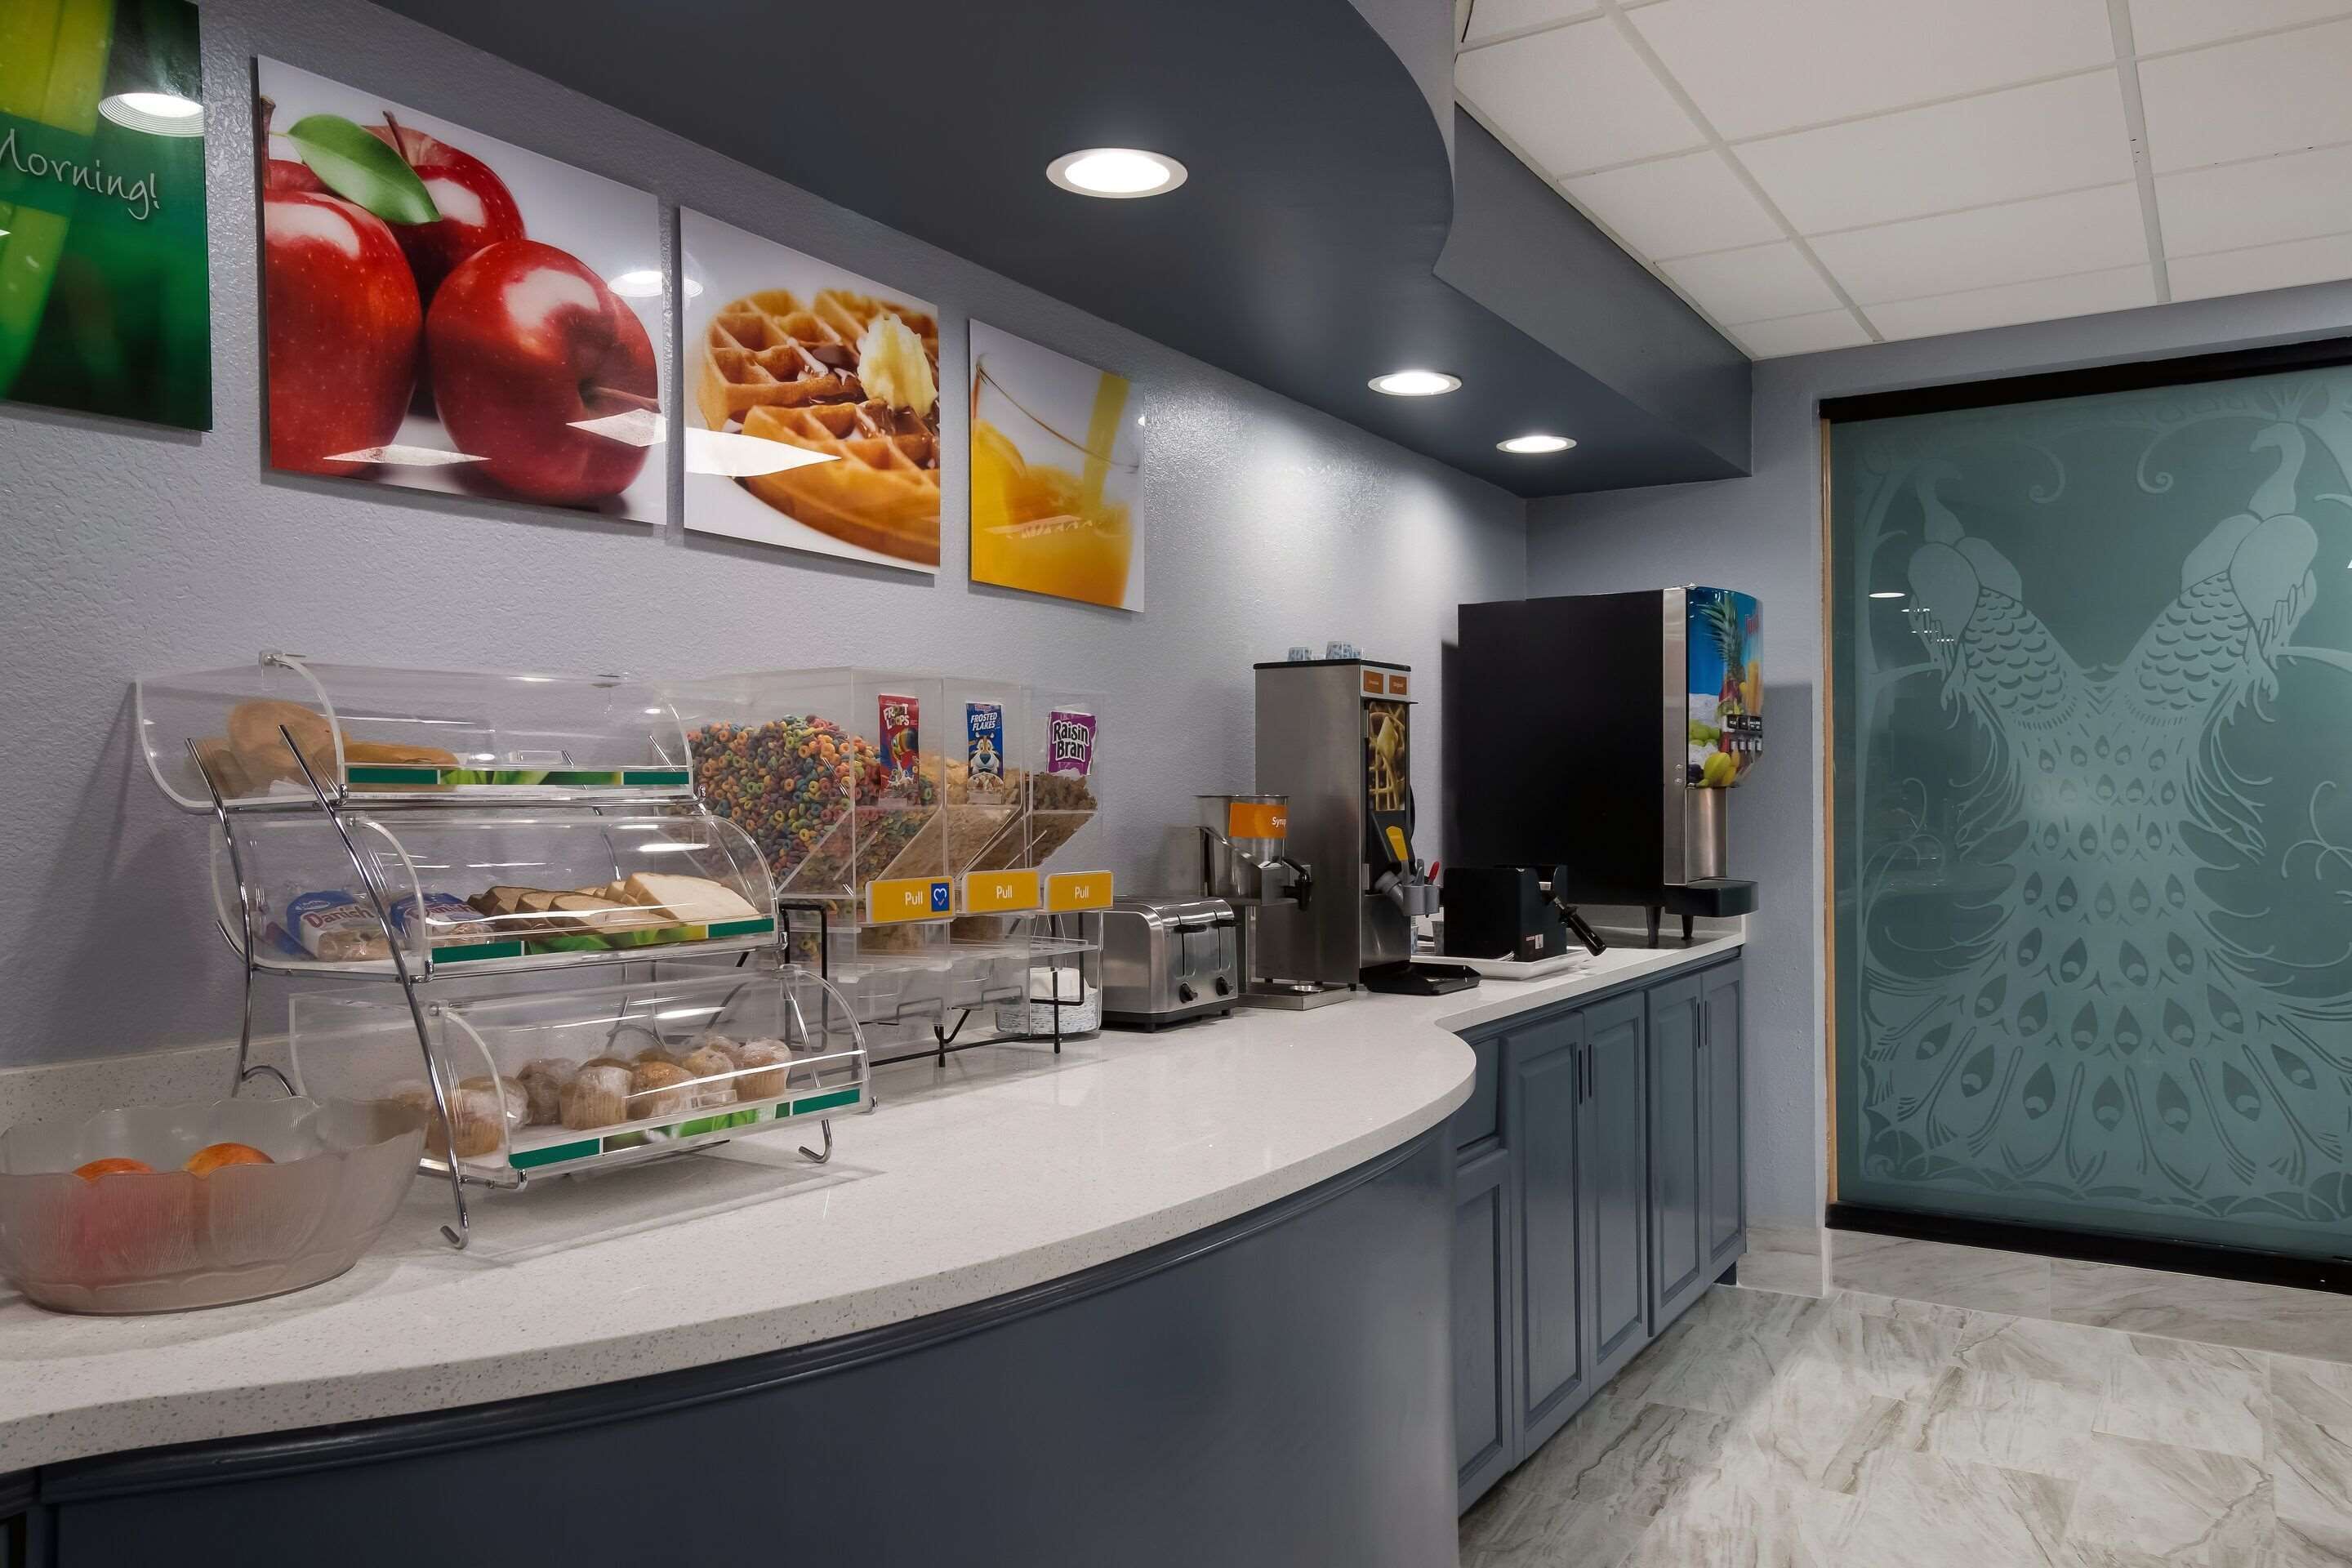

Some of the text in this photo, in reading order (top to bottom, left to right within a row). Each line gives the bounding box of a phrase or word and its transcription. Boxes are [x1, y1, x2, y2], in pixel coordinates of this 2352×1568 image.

[886, 715, 910, 730] LOOPS
[970, 711, 998, 724] FROSTED
[972, 720, 996, 732] FLAKES
[1053, 720, 1089, 746] Raisin
[1057, 740, 1085, 761] Bran
[905, 890, 923, 906] Pull
[996, 884, 1013, 899] Pull
[1075, 885, 1089, 899] Pull
[303, 906, 375, 928] Danish
